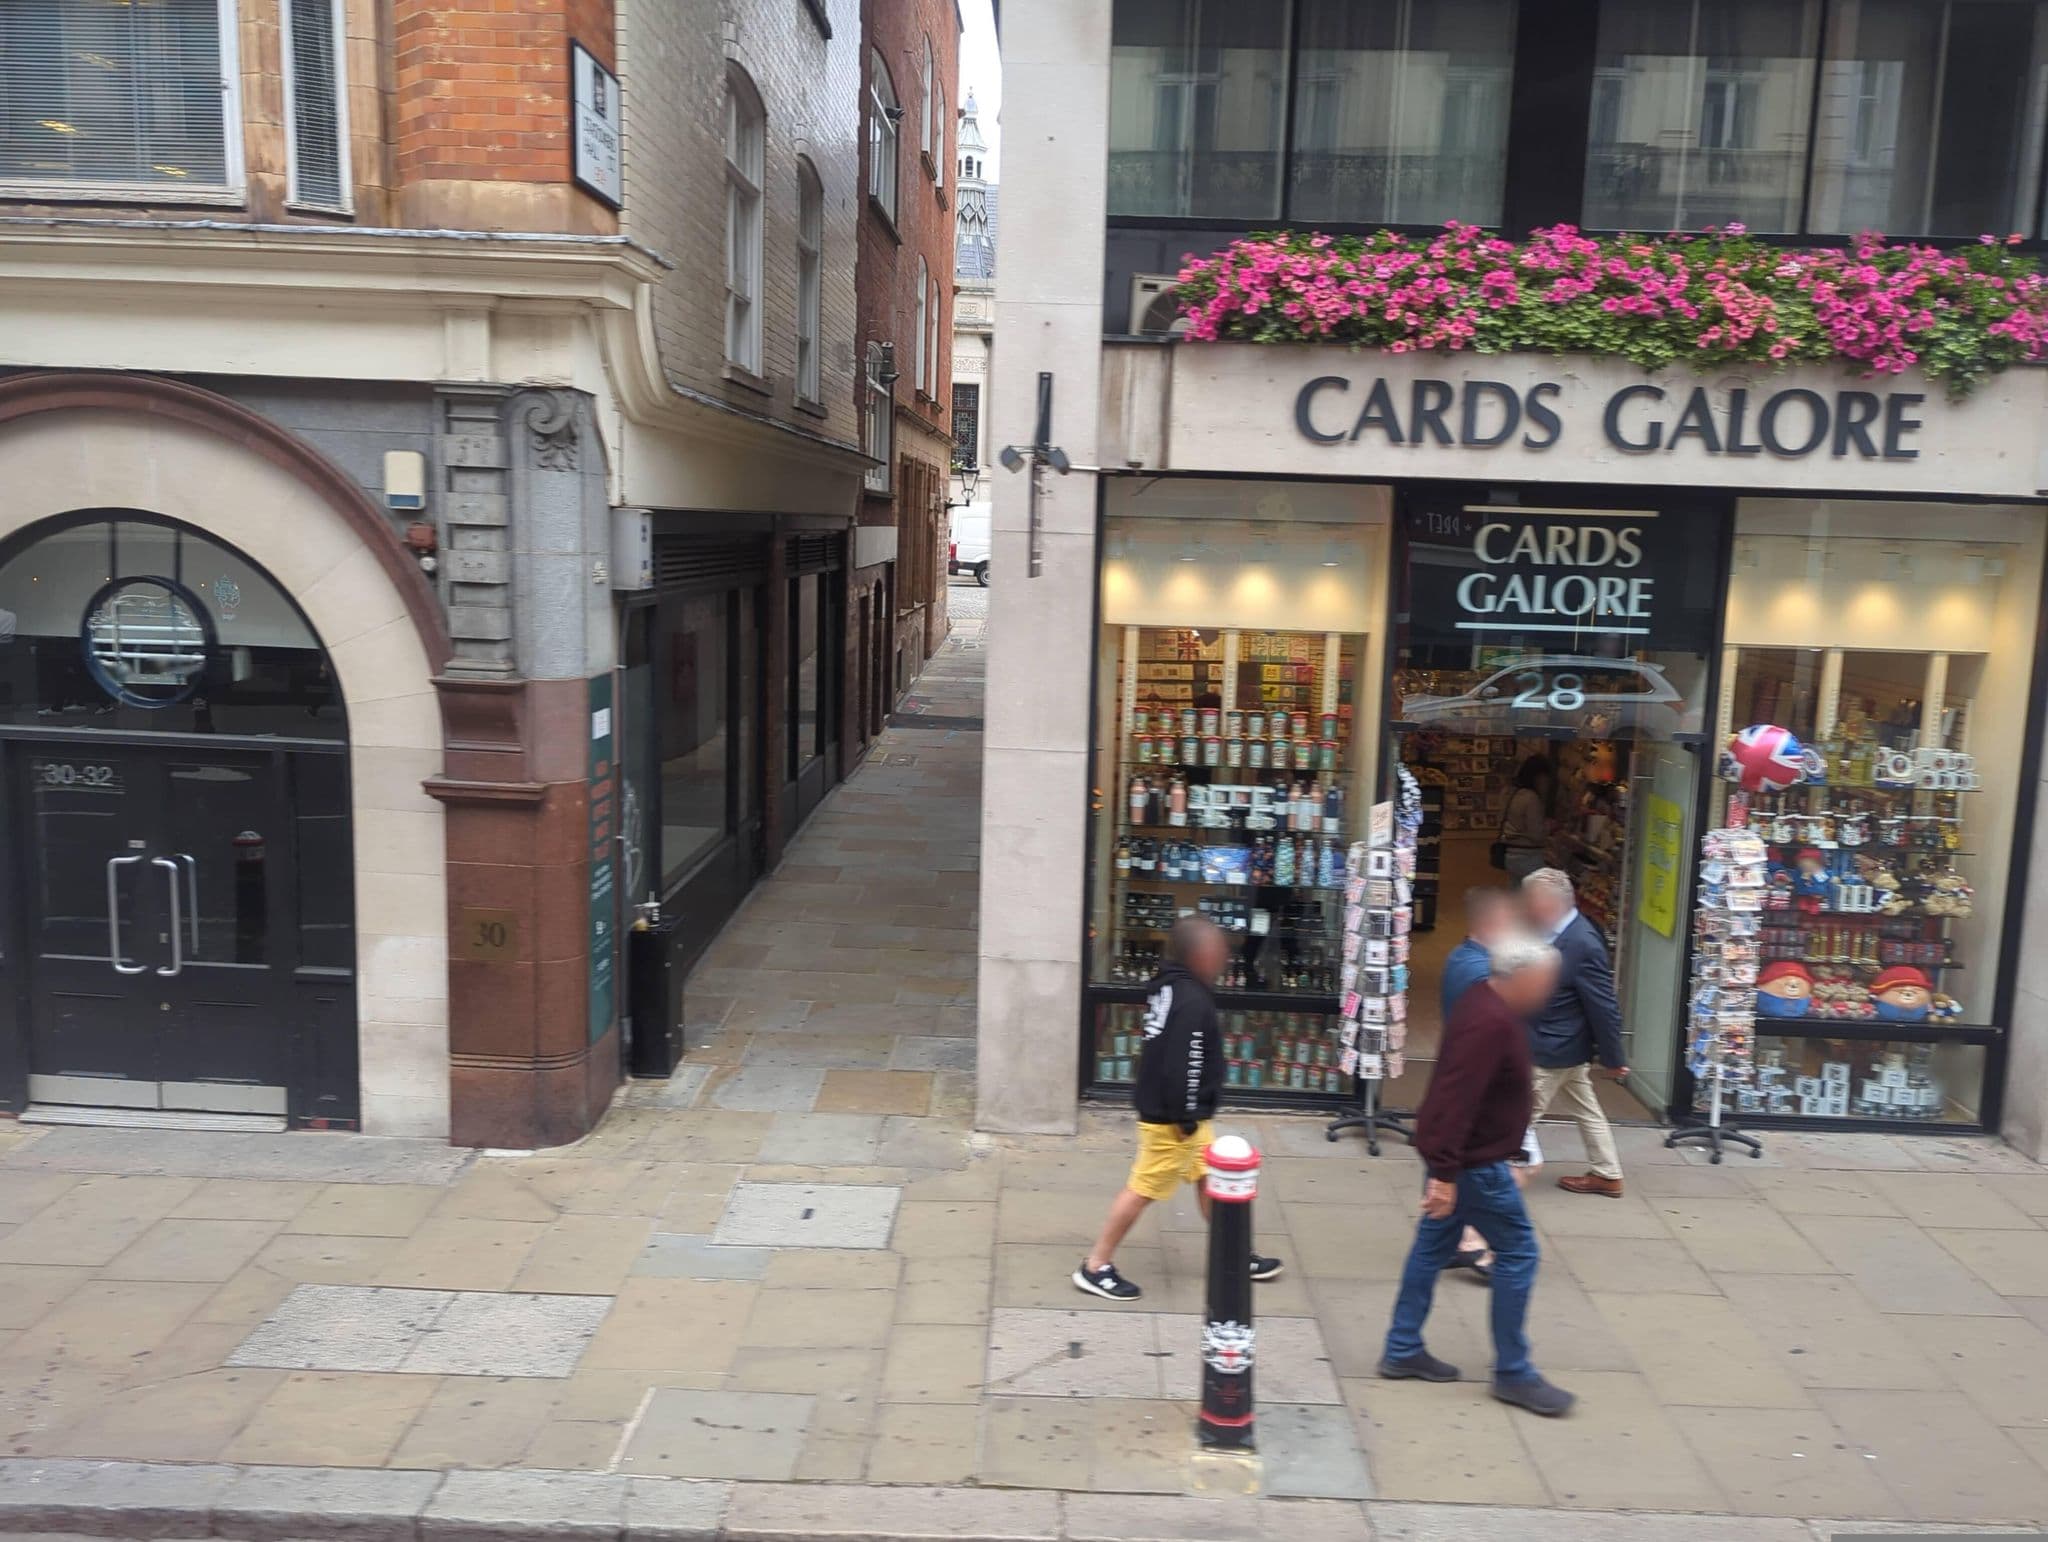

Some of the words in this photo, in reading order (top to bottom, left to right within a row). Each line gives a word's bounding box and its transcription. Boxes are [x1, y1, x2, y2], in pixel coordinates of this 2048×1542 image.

[1295, 376, 1562, 450] CARDS
[1604, 384, 1926, 459] GALORE
[1473, 523, 1643, 568] CARDS
[1456, 572, 1655, 618] GALORE
[1511, 671, 1586, 711] 28
[44, 763, 114, 786] 30-32
[471, 921, 507, 948] 30
